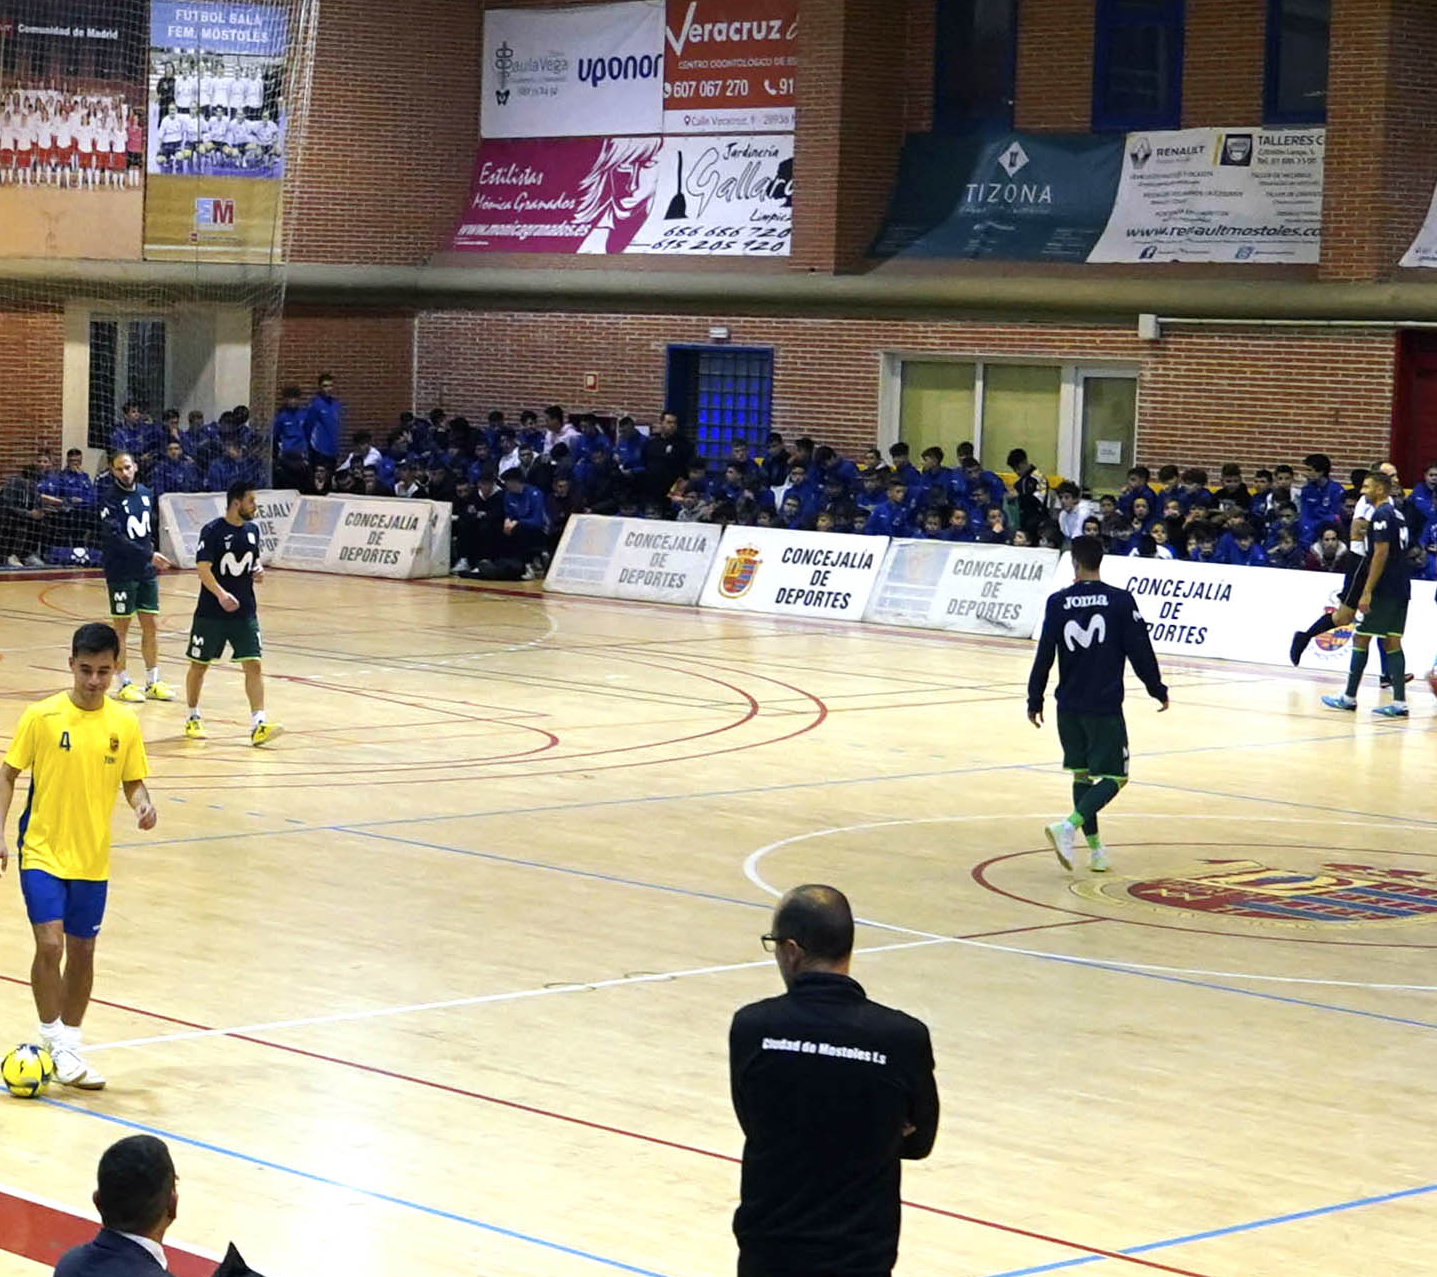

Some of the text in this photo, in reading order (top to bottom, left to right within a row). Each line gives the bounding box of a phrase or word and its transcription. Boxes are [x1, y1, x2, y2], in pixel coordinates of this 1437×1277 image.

[18, 23, 118, 40] Comunidad de Madrid
[666, 1, 782, 56] Veracruz
[578, 54, 663, 88] uponor
[673, 78, 794, 98] 607 067 270 91
[1156, 135, 1314, 157] RENAULT TALLERES
[479, 162, 544, 186] Estilistas
[513, 191, 575, 212] Granados
[966, 183, 1052, 203] TIZONA
[344, 512, 419, 531] CONCEJALÍA
[367, 531, 385, 546] DE
[624, 530, 707, 554] CONCEJALÍA
[339, 546, 401, 564] DEPORTES
[649, 551, 667, 568] DE
[781, 546, 873, 570] CONCEJALÍA
[619, 566, 688, 589] DEPORTES
[810, 570, 828, 586] DE
[952, 558, 1044, 582] CONCEJALÍA
[774, 587, 853, 610] DEPORTES
[981, 581, 1000, 597] DE
[1126, 576, 1233, 602] CONCEJALÍA
[945, 598, 1023, 621] DEPORTES
[1159, 602, 1183, 620] DE
[1145, 623, 1208, 645] PORTES
[59, 731, 71, 752] 4
[762, 1036, 871, 1063] Ciudad de Mostoles
